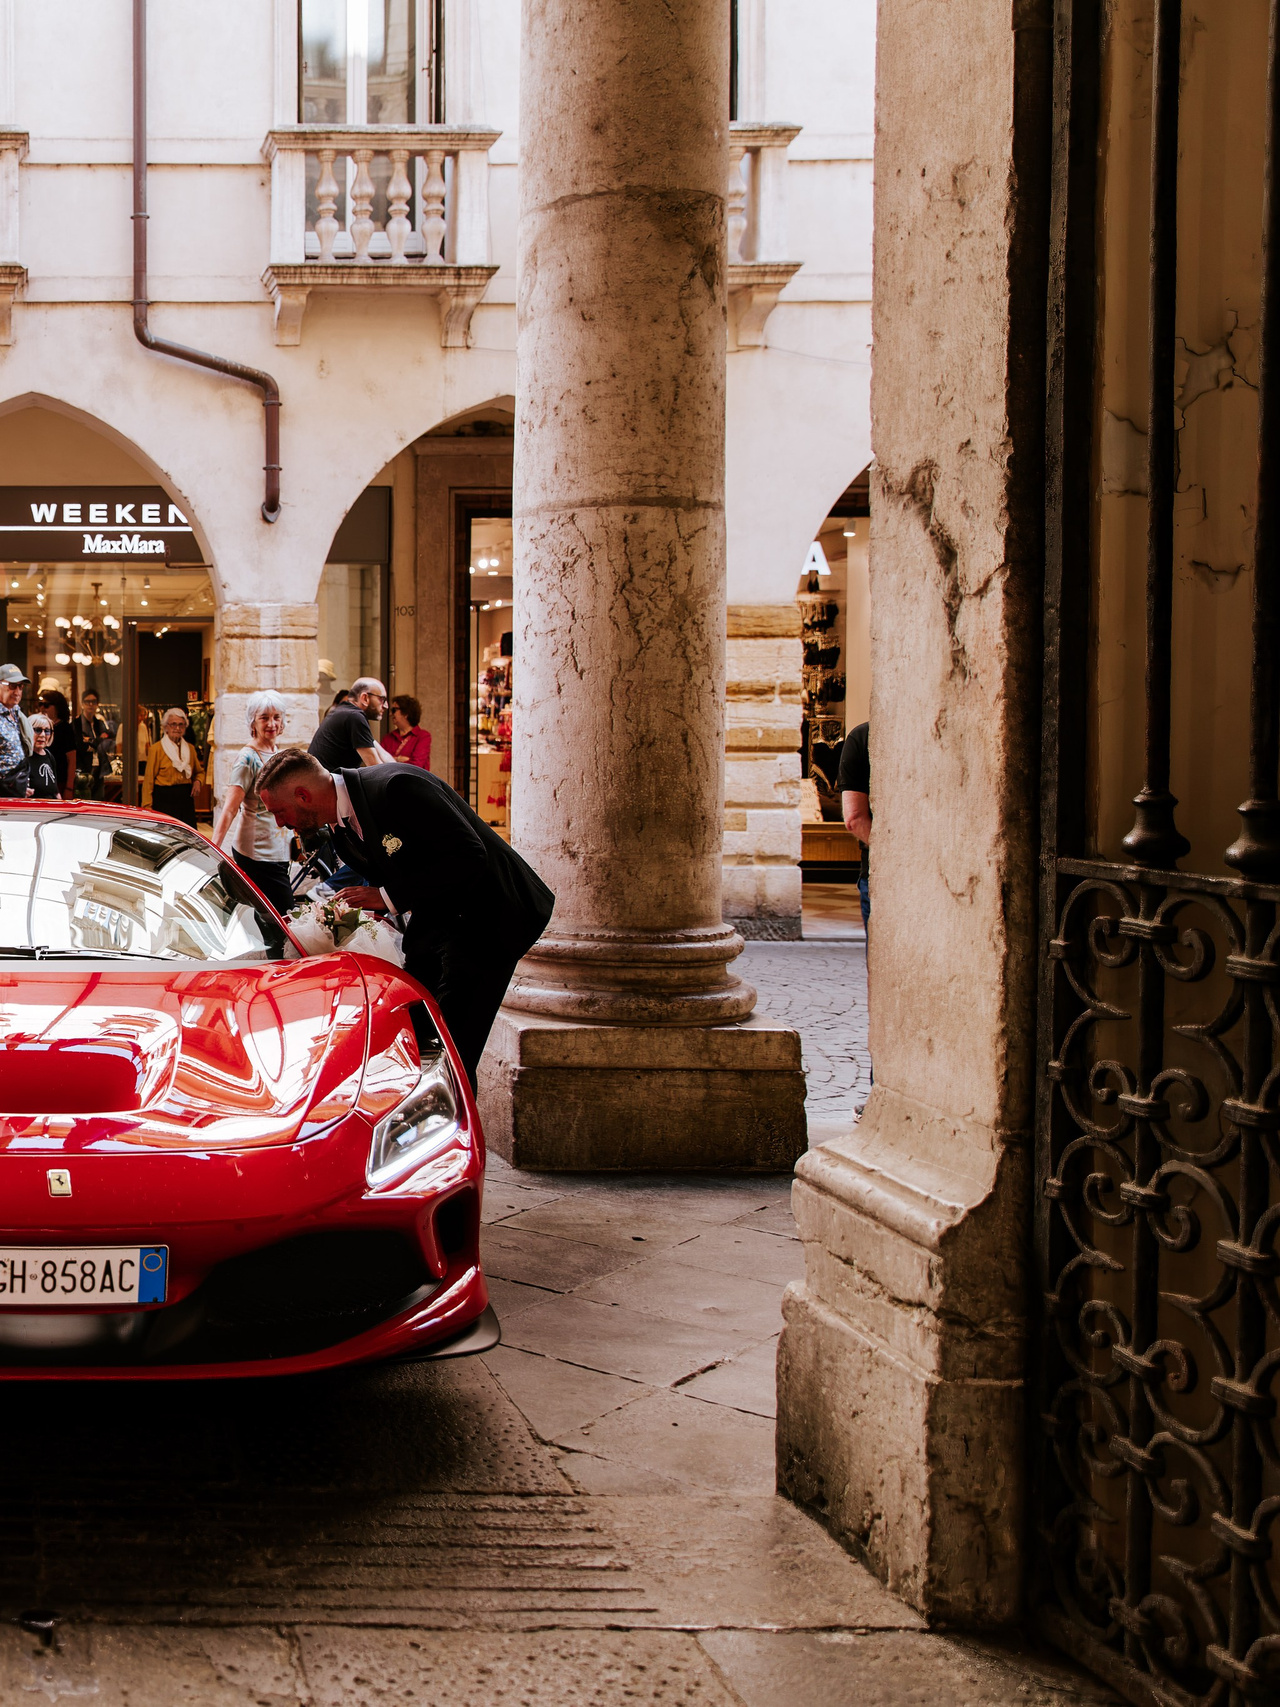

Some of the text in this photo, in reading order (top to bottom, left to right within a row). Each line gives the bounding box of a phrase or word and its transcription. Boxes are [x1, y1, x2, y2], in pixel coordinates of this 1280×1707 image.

[82, 533, 166, 554] MaxMara
[800, 540, 832, 576] A
[394, 605, 415, 617] 103
[40, 1259, 136, 1294] 858AC
